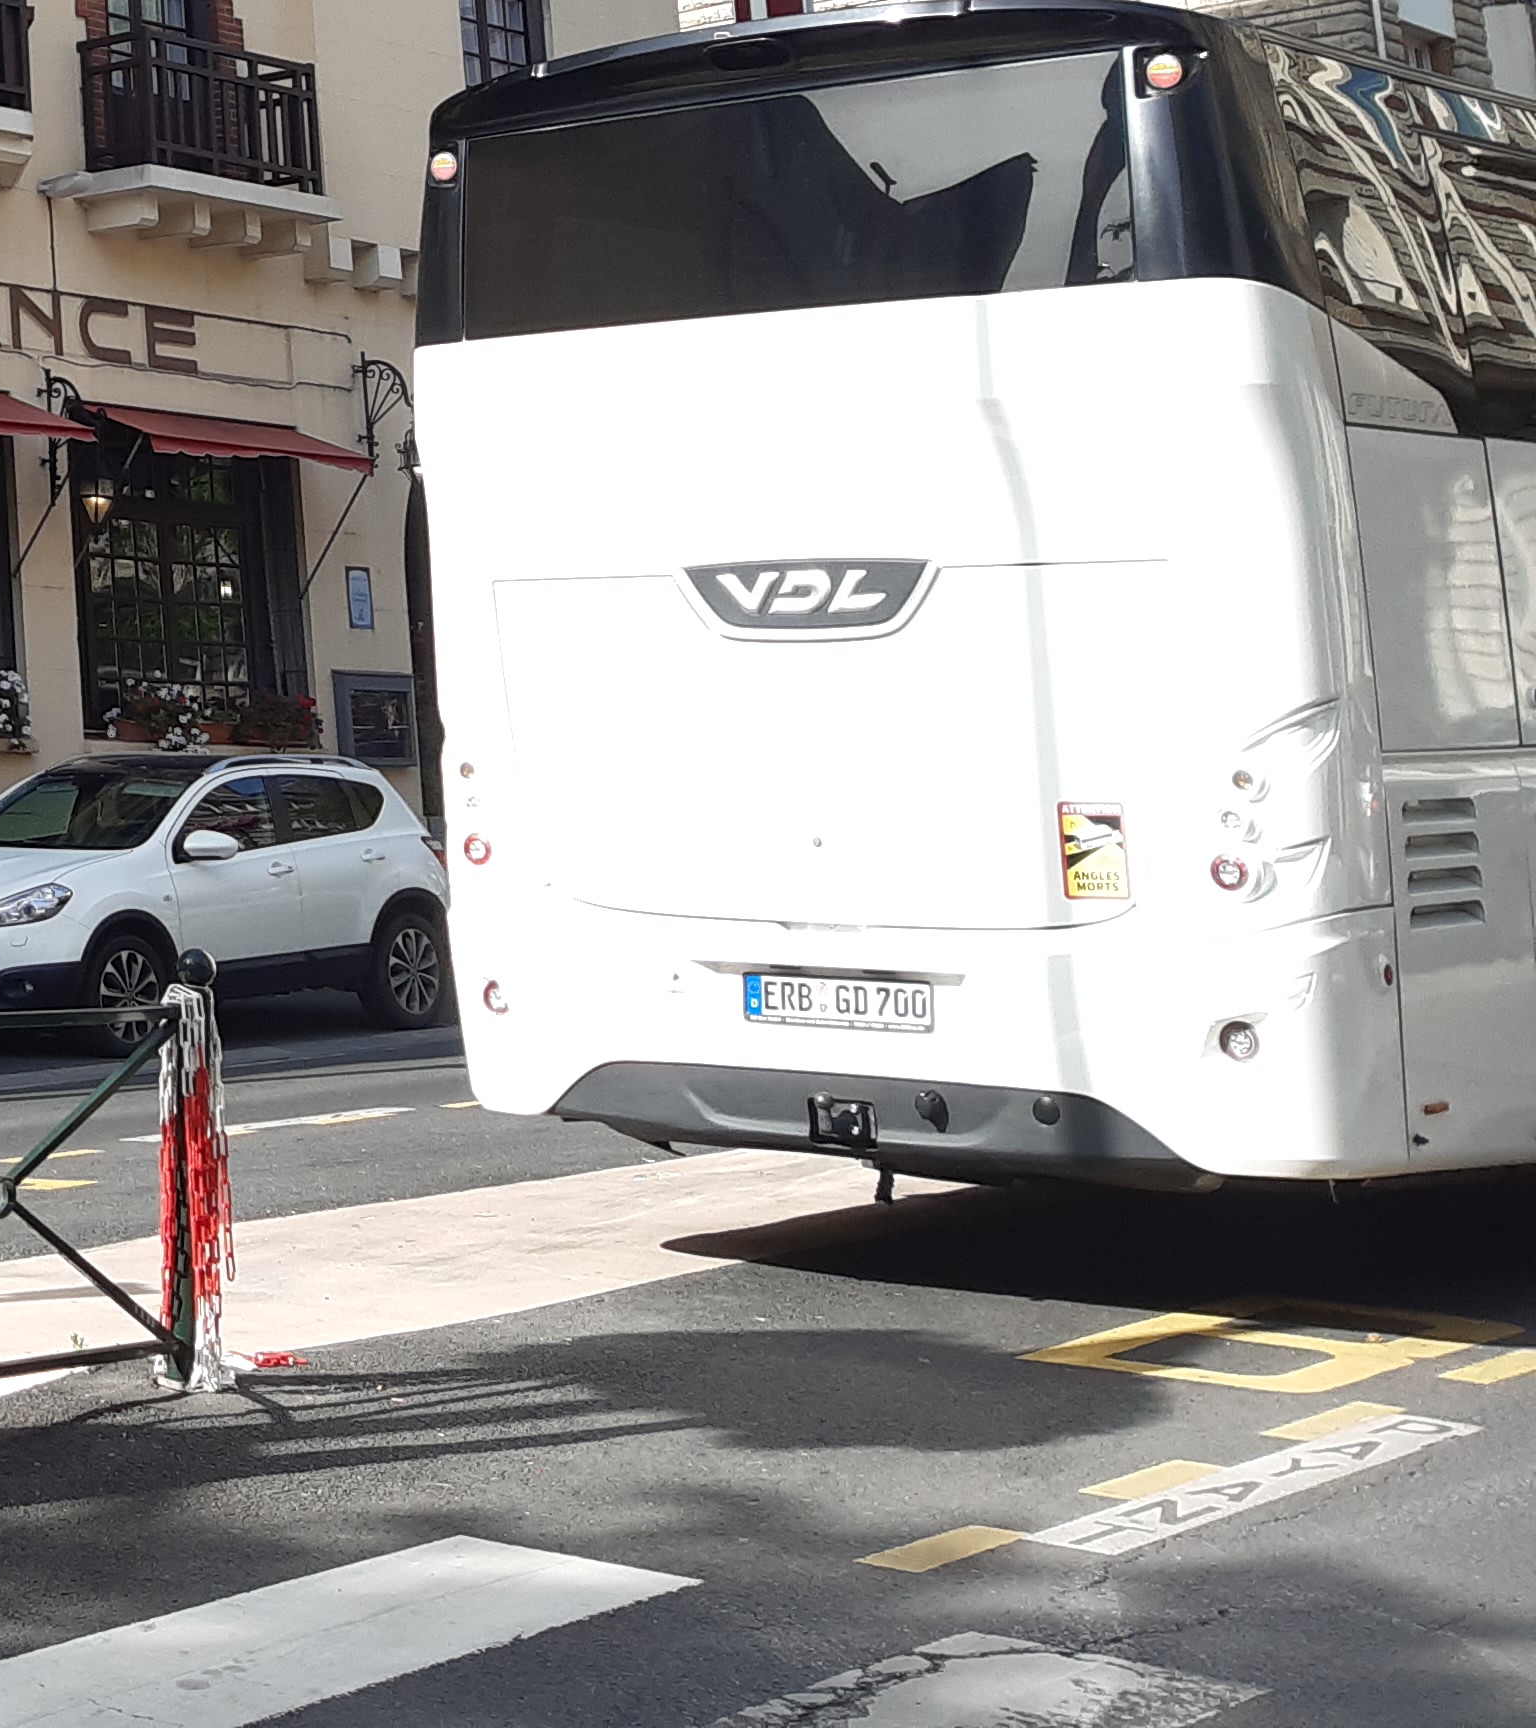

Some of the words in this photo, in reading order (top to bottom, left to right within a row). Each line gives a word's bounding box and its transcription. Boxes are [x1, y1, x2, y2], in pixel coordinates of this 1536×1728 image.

[714, 568, 889, 616] VDL
[1073, 871, 1120, 881] ANGLES
[1076, 882, 1119, 892] MORTS
[764, 981, 813, 1012] ERB
